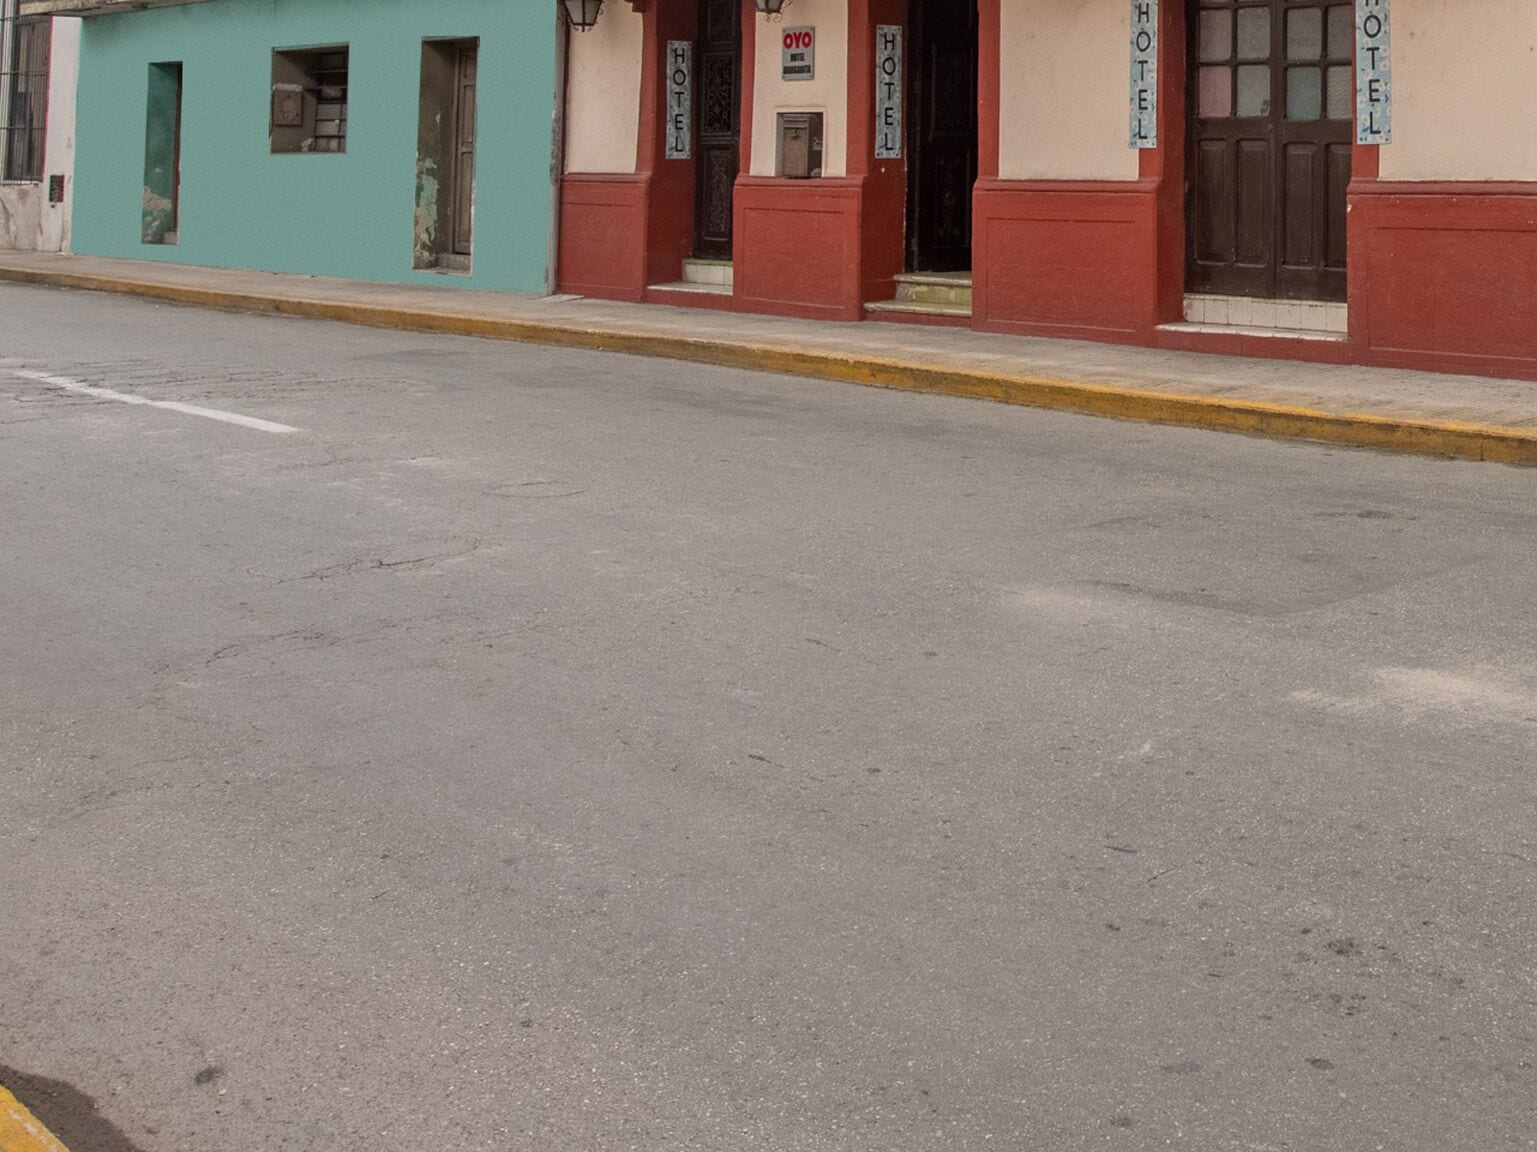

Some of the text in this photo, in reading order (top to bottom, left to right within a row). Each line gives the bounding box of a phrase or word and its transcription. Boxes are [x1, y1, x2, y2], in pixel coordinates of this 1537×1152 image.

[783, 31, 812, 49] OYO
[882, 32, 897, 151] HOTEL
[1135, 2, 1152, 140] HOTEL
[673, 47, 687, 153] HOTEL
